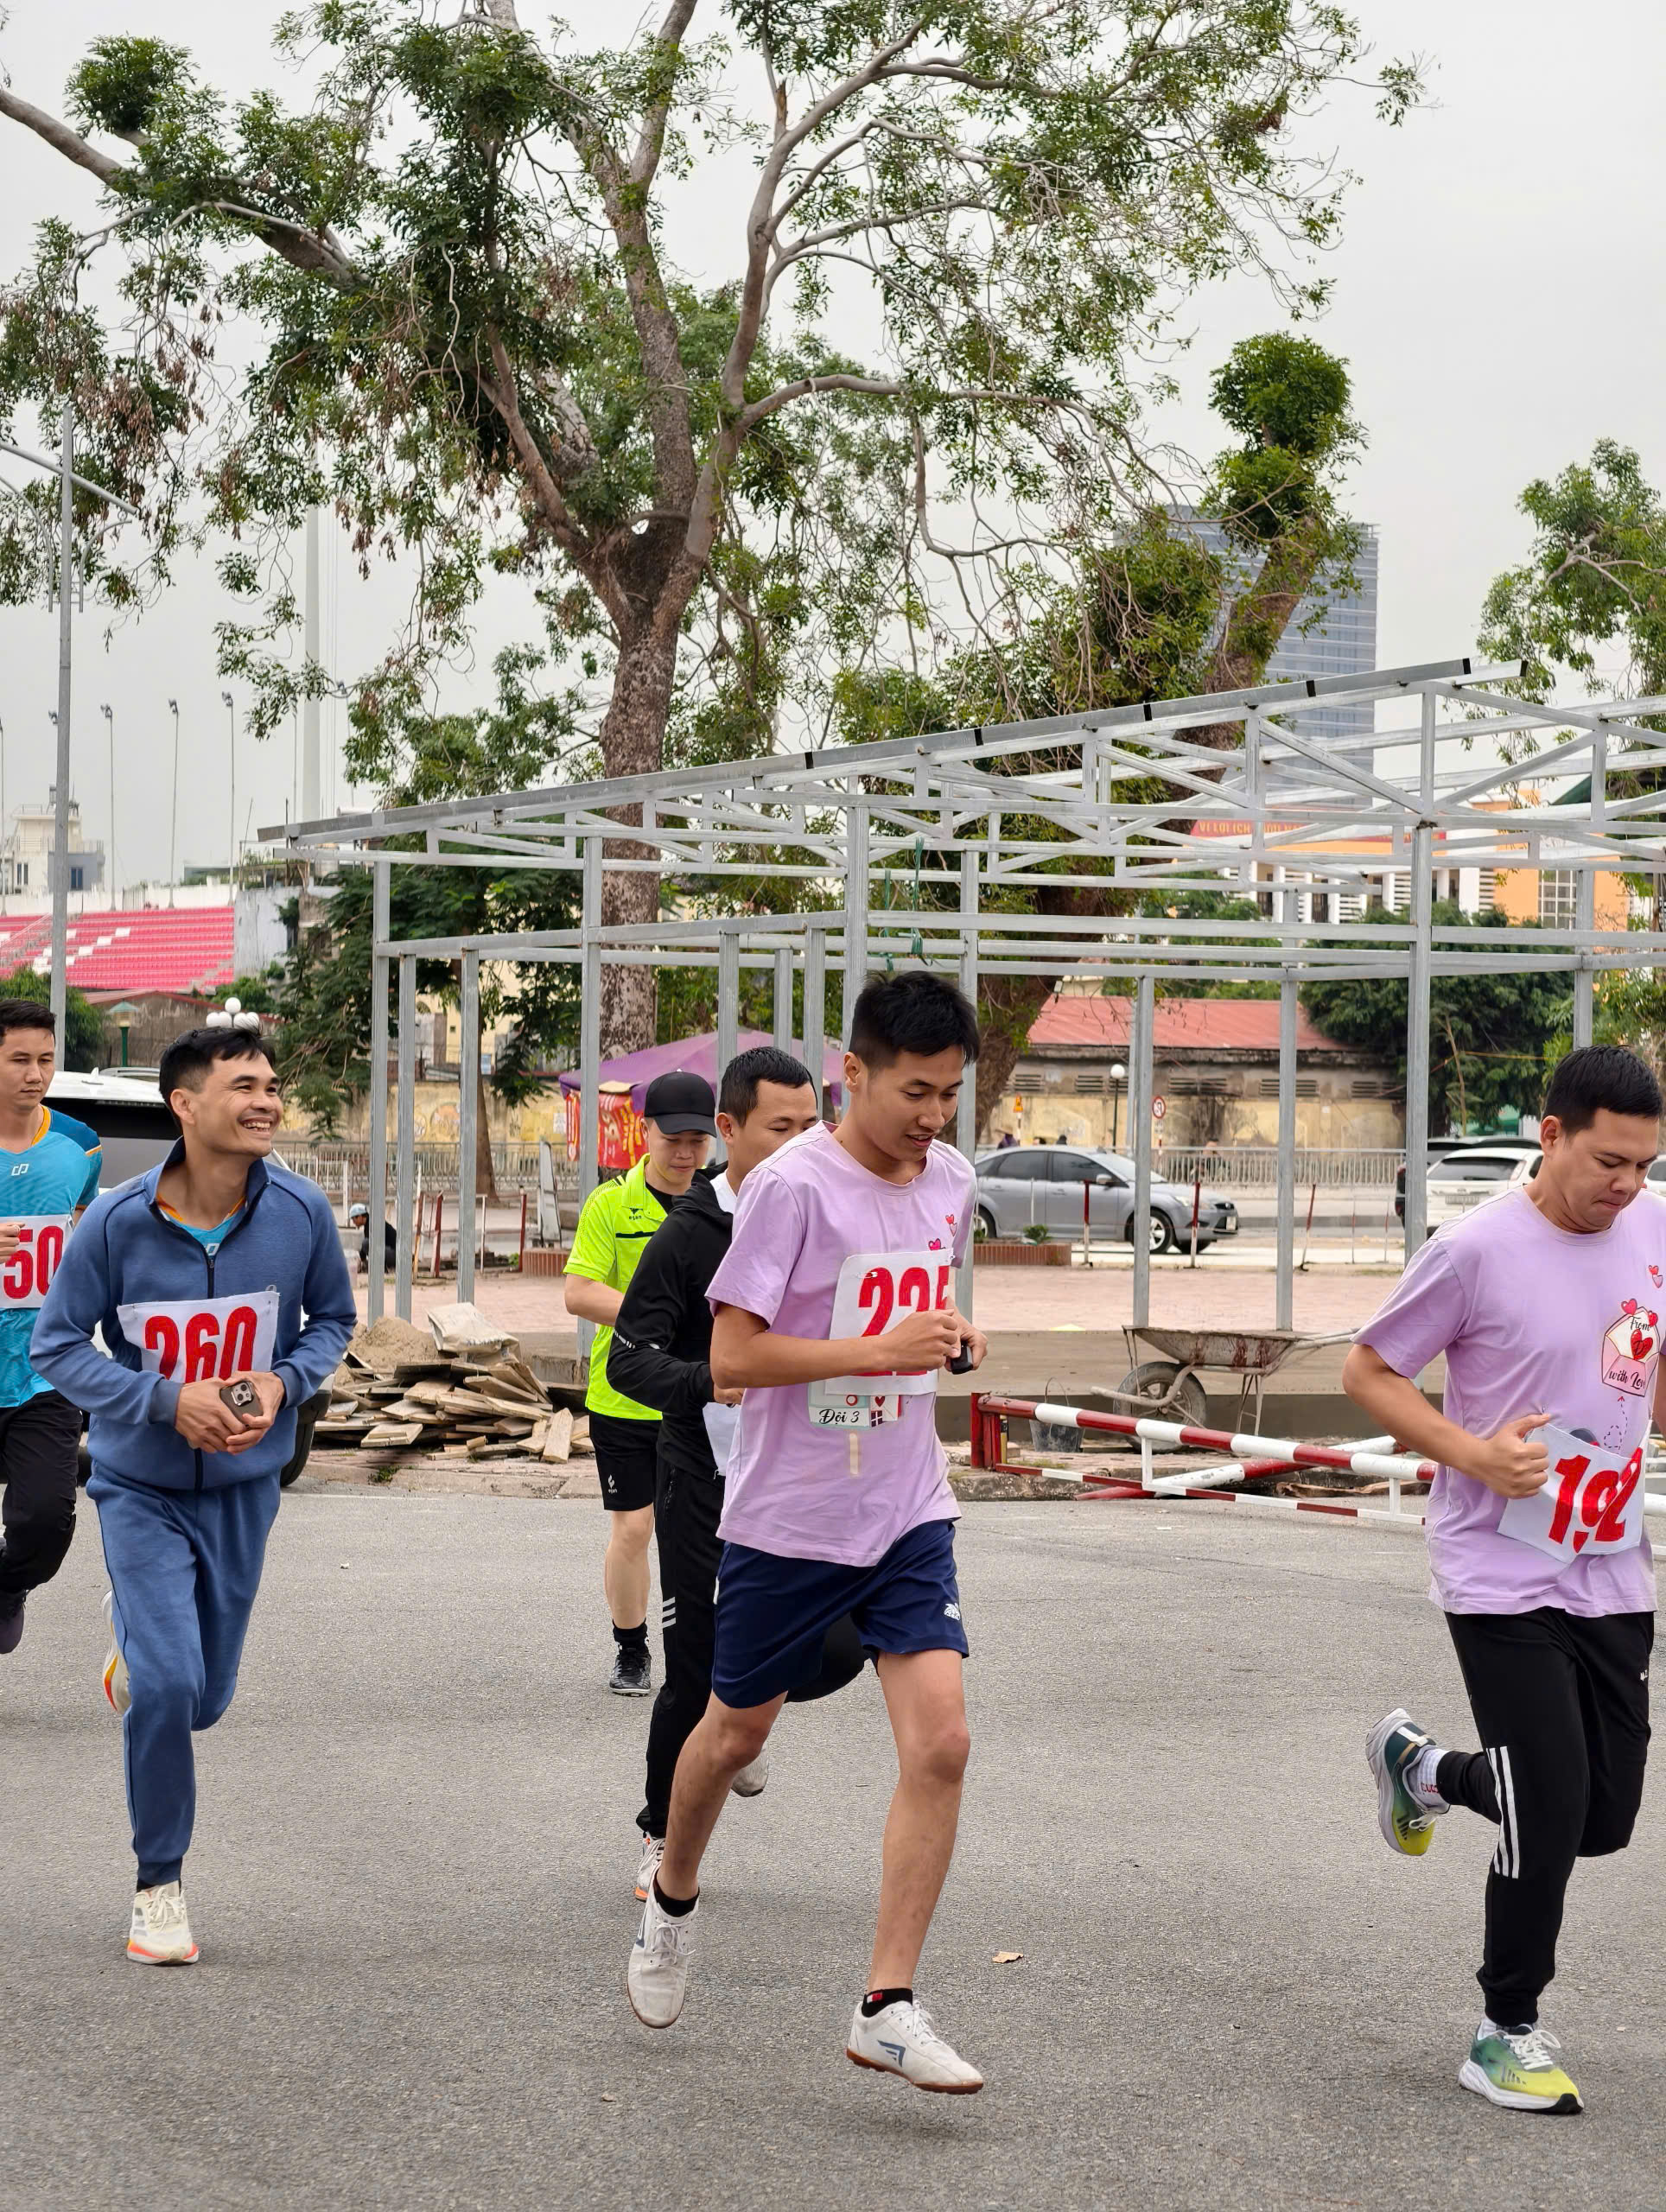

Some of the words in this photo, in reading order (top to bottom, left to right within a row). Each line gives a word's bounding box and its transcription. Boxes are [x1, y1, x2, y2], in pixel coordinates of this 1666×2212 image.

[1630, 1316, 1650, 1332] From
[145, 1306, 258, 1383] 260
[1609, 1370, 1628, 1384] with
[1631, 1371, 1646, 1390] Lov
[818, 1408, 847, 1425] Đội
[850, 1410, 860, 1423] 3
